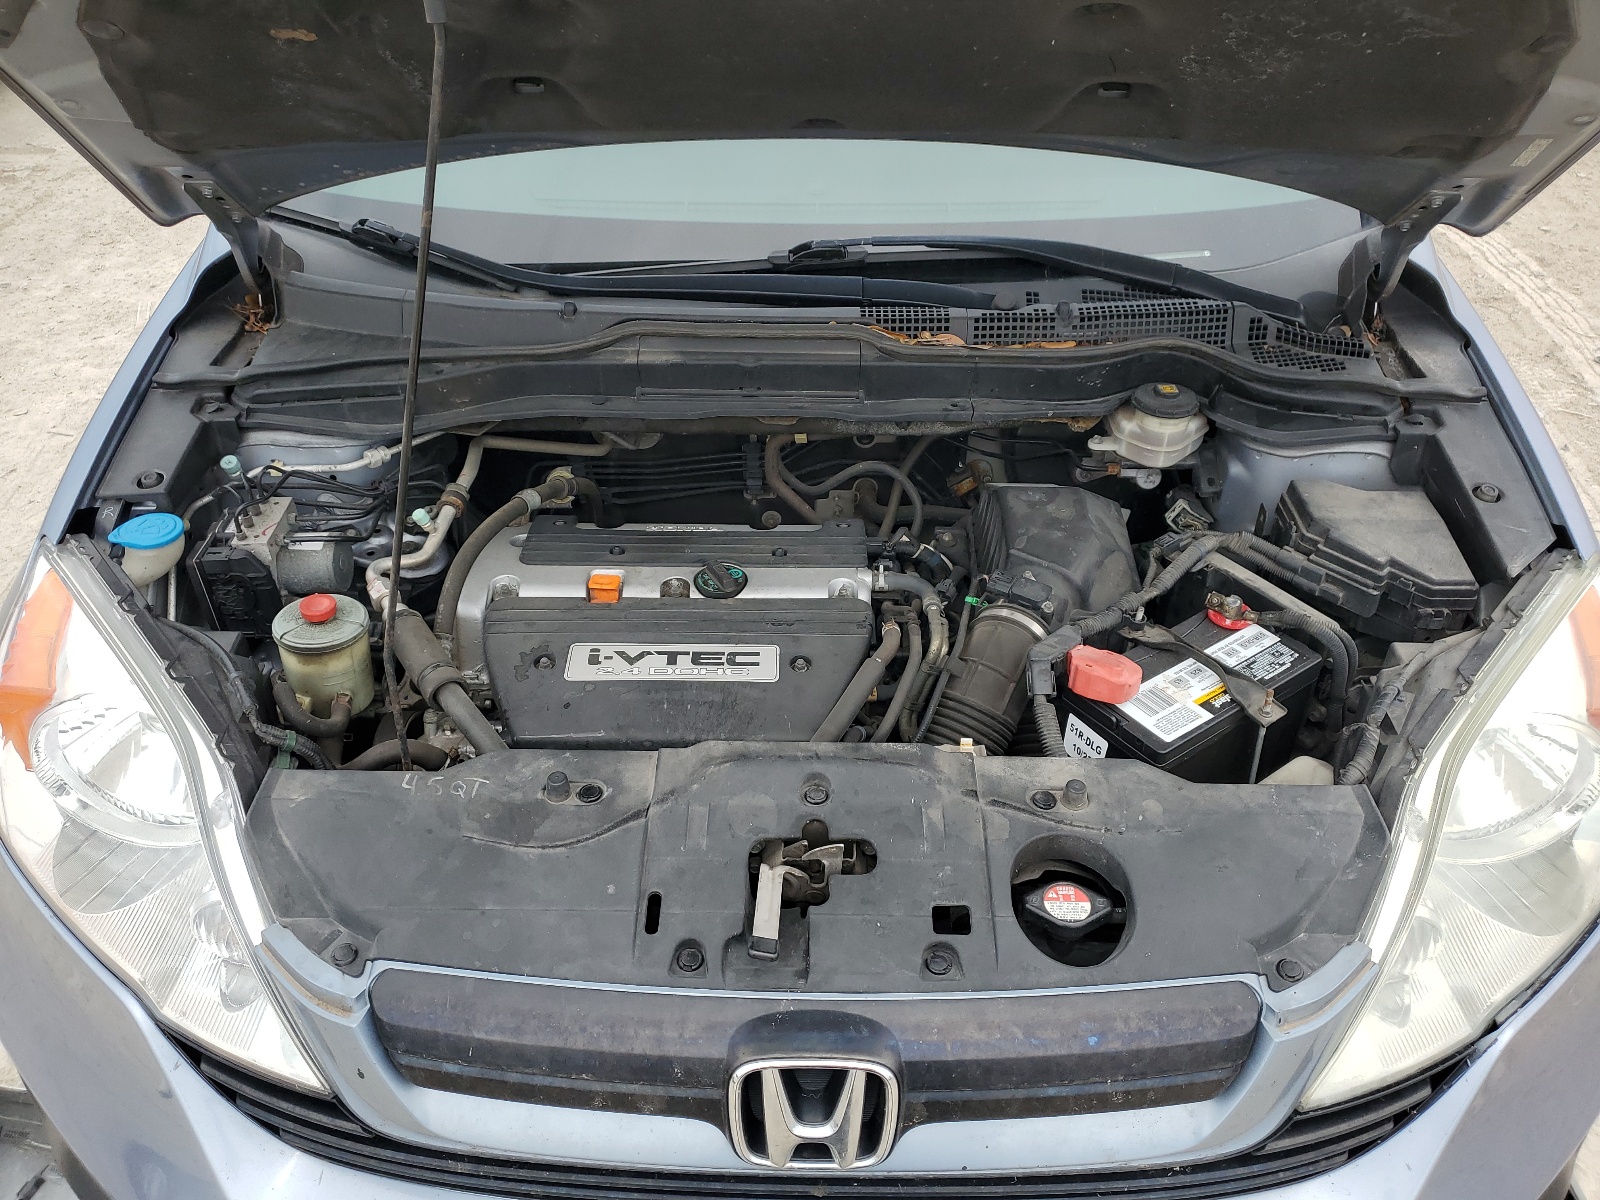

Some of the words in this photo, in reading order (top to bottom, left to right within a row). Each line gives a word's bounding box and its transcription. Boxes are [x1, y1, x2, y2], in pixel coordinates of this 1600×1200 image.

[588, 648, 760, 667] i-VTEC
[648, 667, 750, 676] DOHC
[1069, 722, 1103, 756] 51R-DLG
[450, 777, 490, 799] QT
